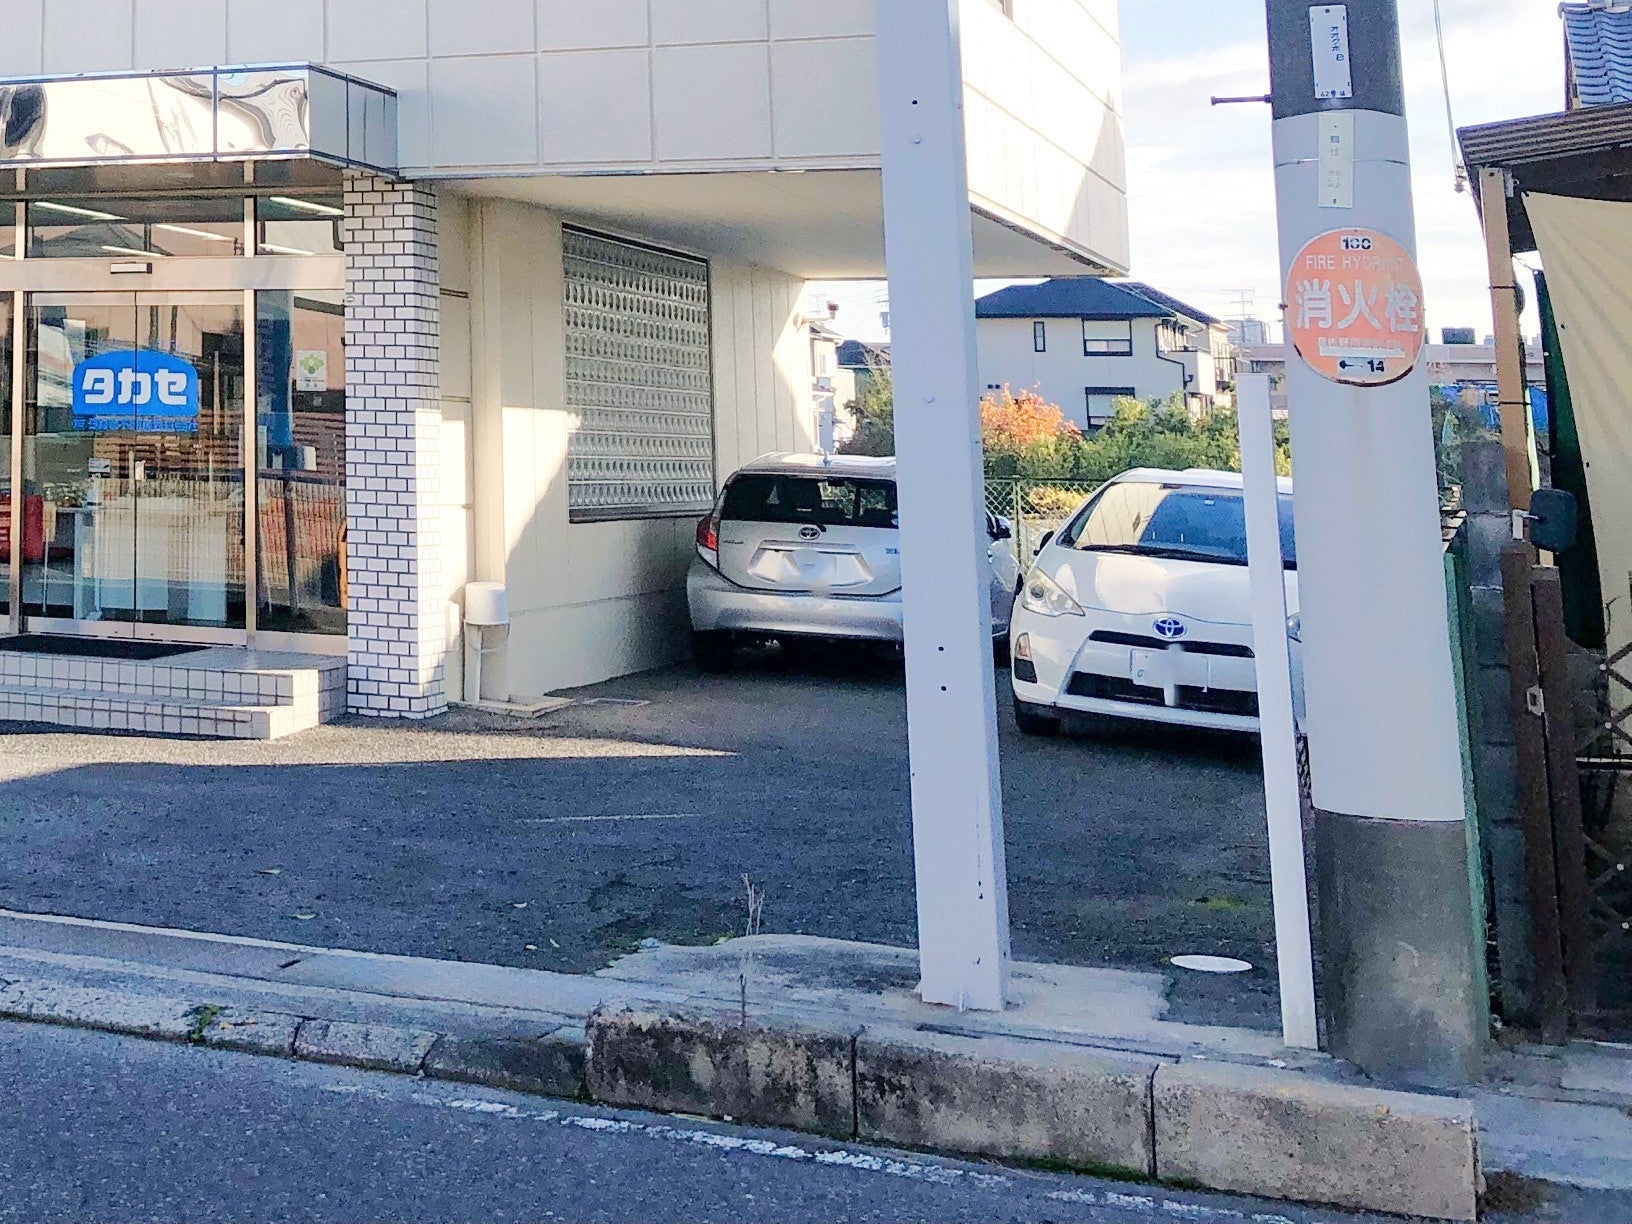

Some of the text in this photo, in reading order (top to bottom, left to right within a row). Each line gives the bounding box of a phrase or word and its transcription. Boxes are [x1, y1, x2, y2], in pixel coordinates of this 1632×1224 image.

[1306, 254, 1335, 270] FIRE
[1294, 277, 1419, 333] 消火栓
[82, 367, 187, 406] タカセ
